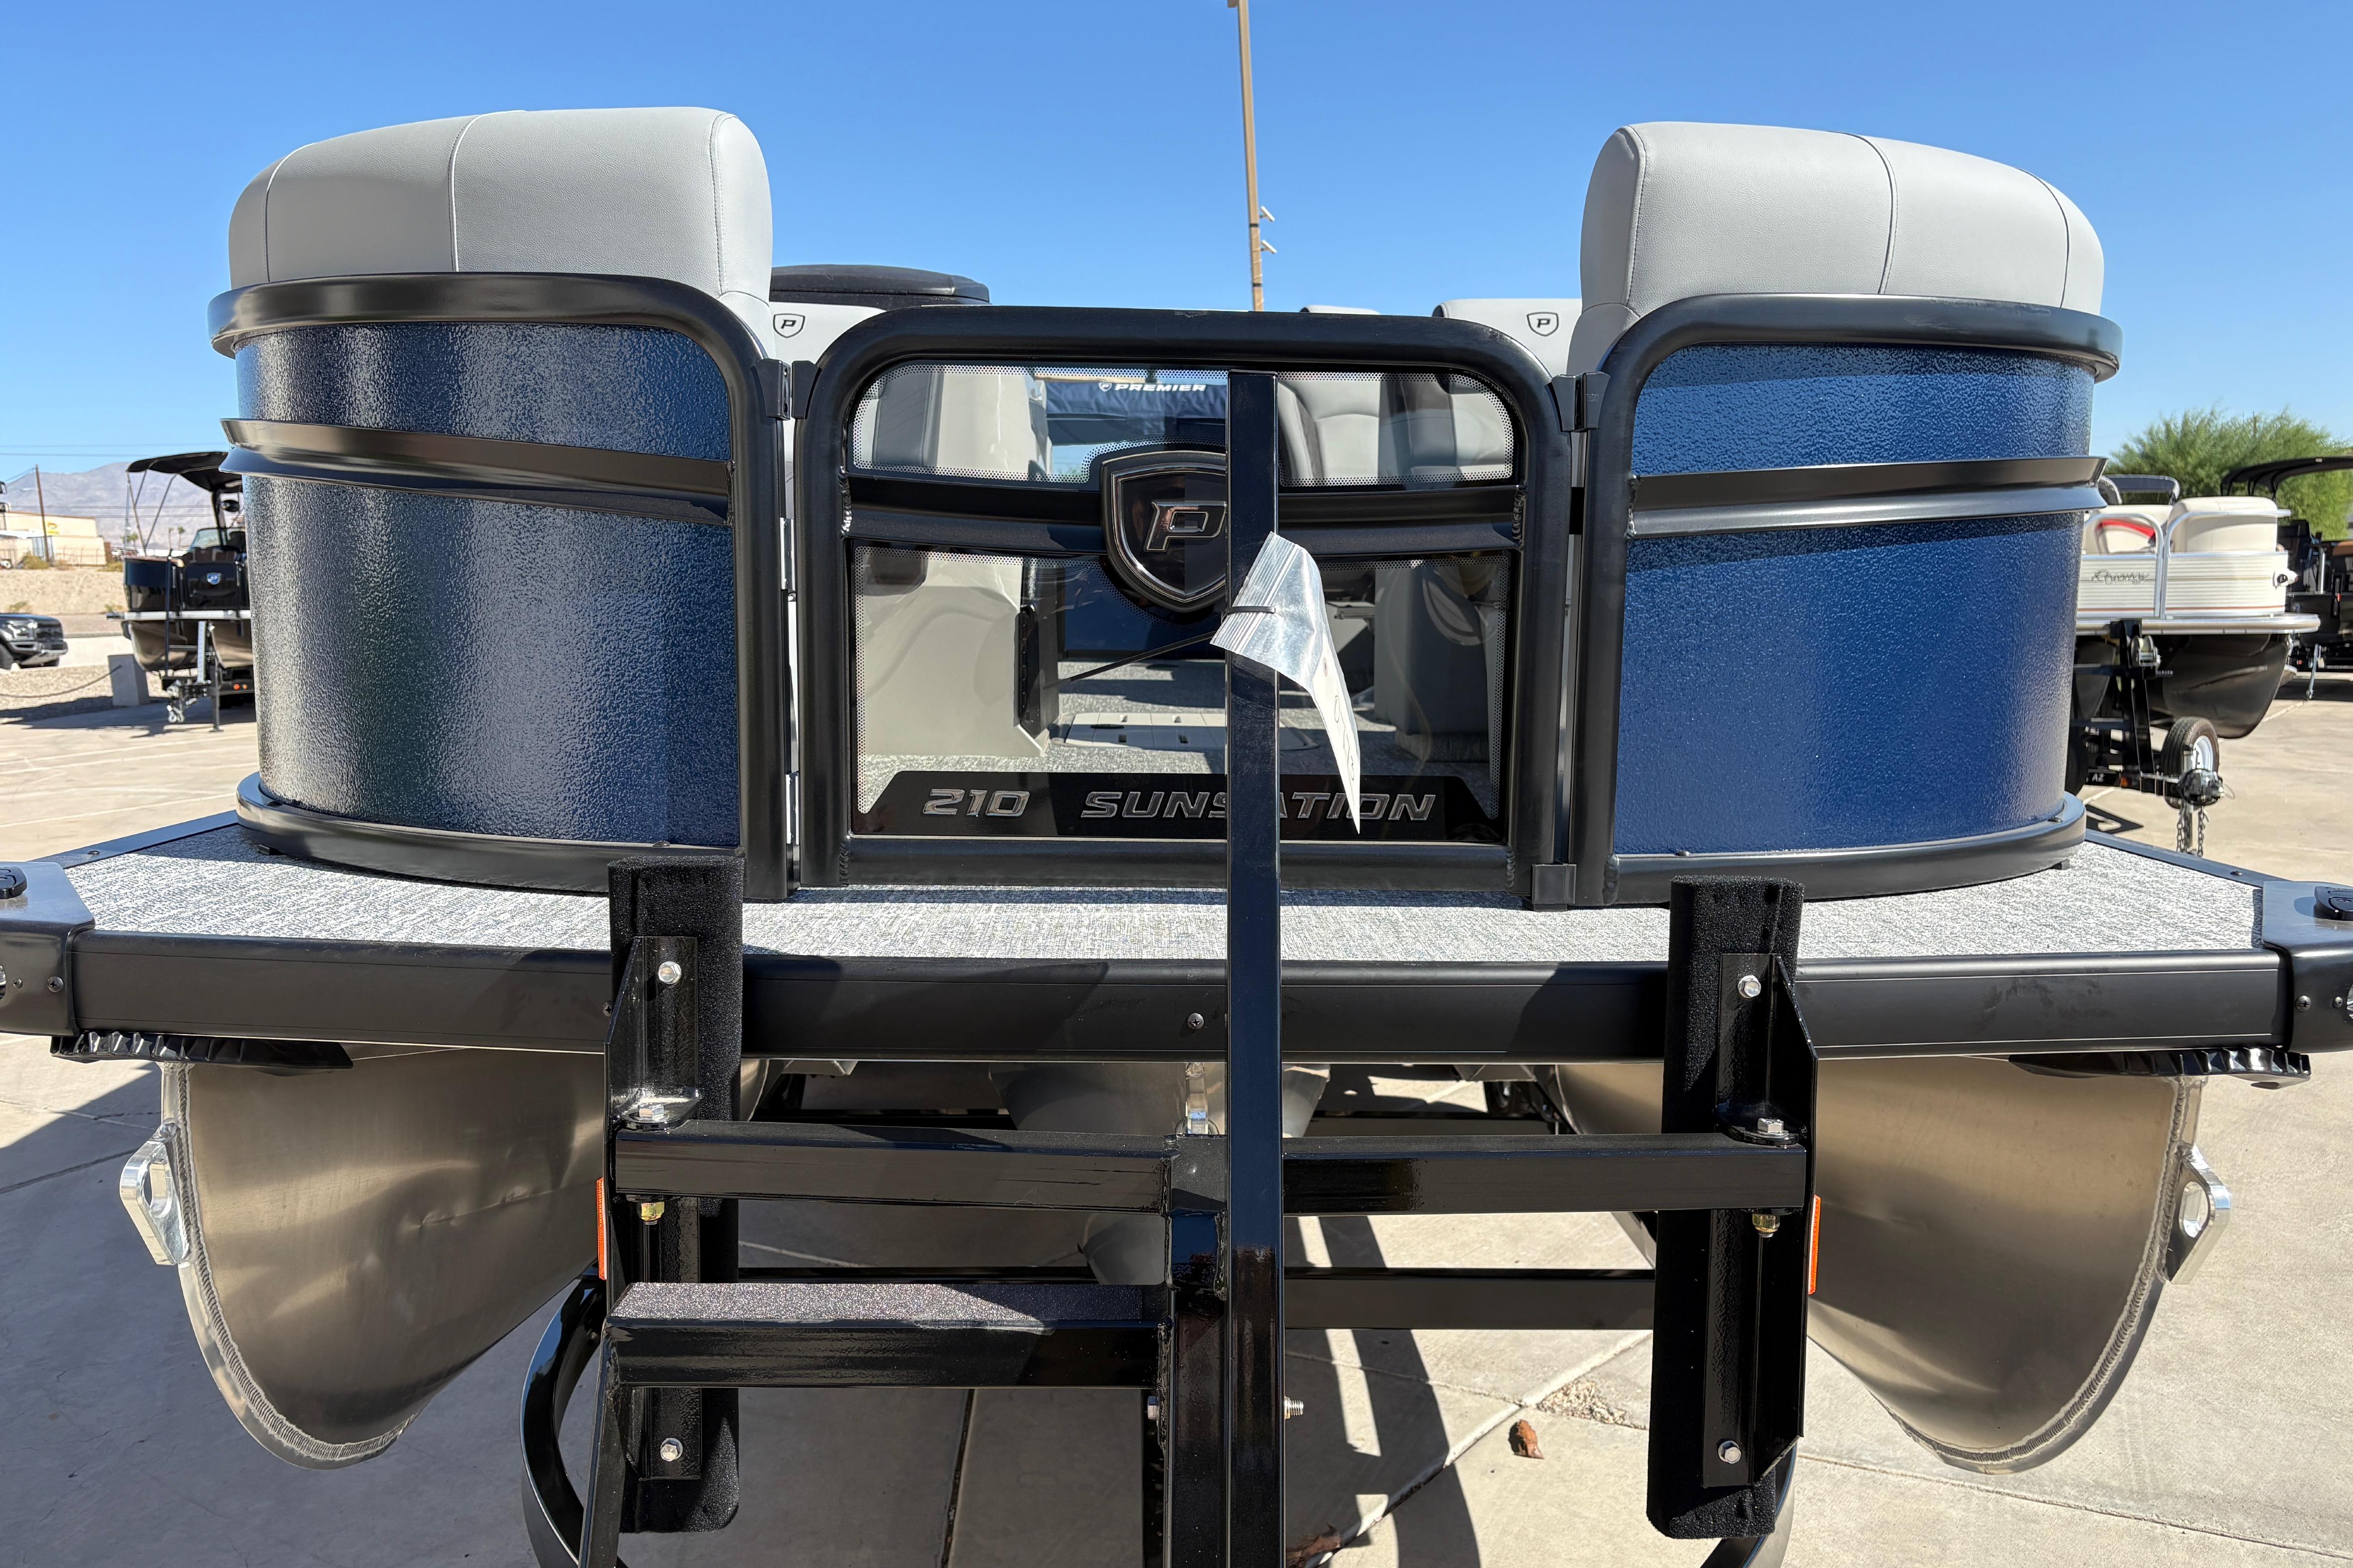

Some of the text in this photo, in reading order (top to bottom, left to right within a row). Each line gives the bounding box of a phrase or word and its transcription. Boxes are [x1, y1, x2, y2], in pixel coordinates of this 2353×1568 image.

[781, 319, 797, 329] P
[1536, 318, 1551, 328] P
[1144, 500, 1227, 552] P
[922, 788, 1436, 821] 210 SUNTION
